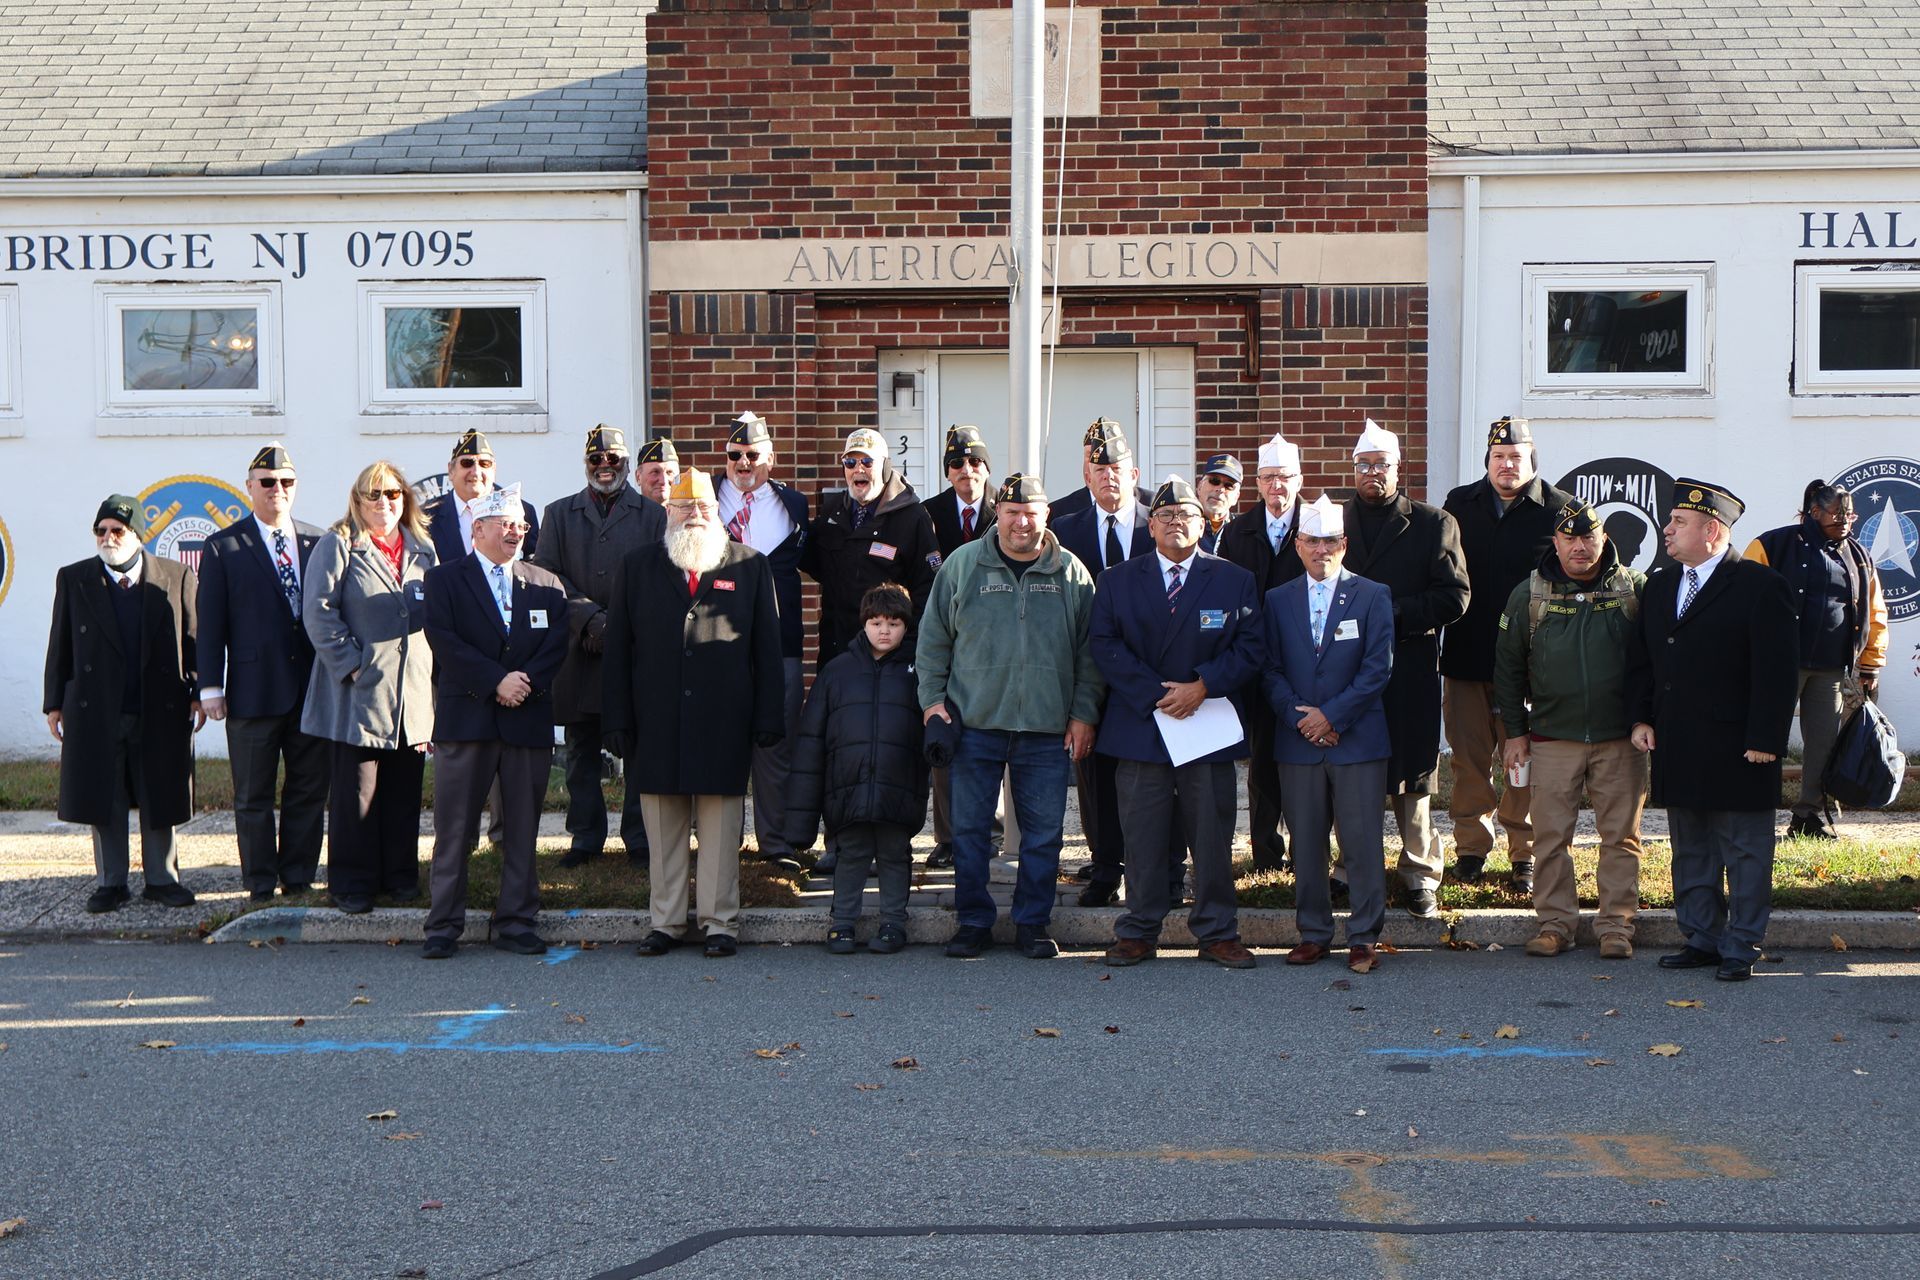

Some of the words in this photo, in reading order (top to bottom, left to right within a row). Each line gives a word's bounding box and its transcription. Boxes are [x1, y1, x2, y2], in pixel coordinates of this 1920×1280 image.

[1798, 211, 1917, 248] HAL
[4, 233, 214, 271] BRIDGE
[250, 232, 309, 279] NJ
[347, 230, 474, 267] 07095
[1085, 241, 1282, 280] LEGION
[1845, 463, 1897, 487] STATES
[1576, 475, 1614, 507] POW
[1625, 475, 1661, 528] MIA
[163, 520, 196, 541] STATES
[1892, 601, 1919, 616] THE
